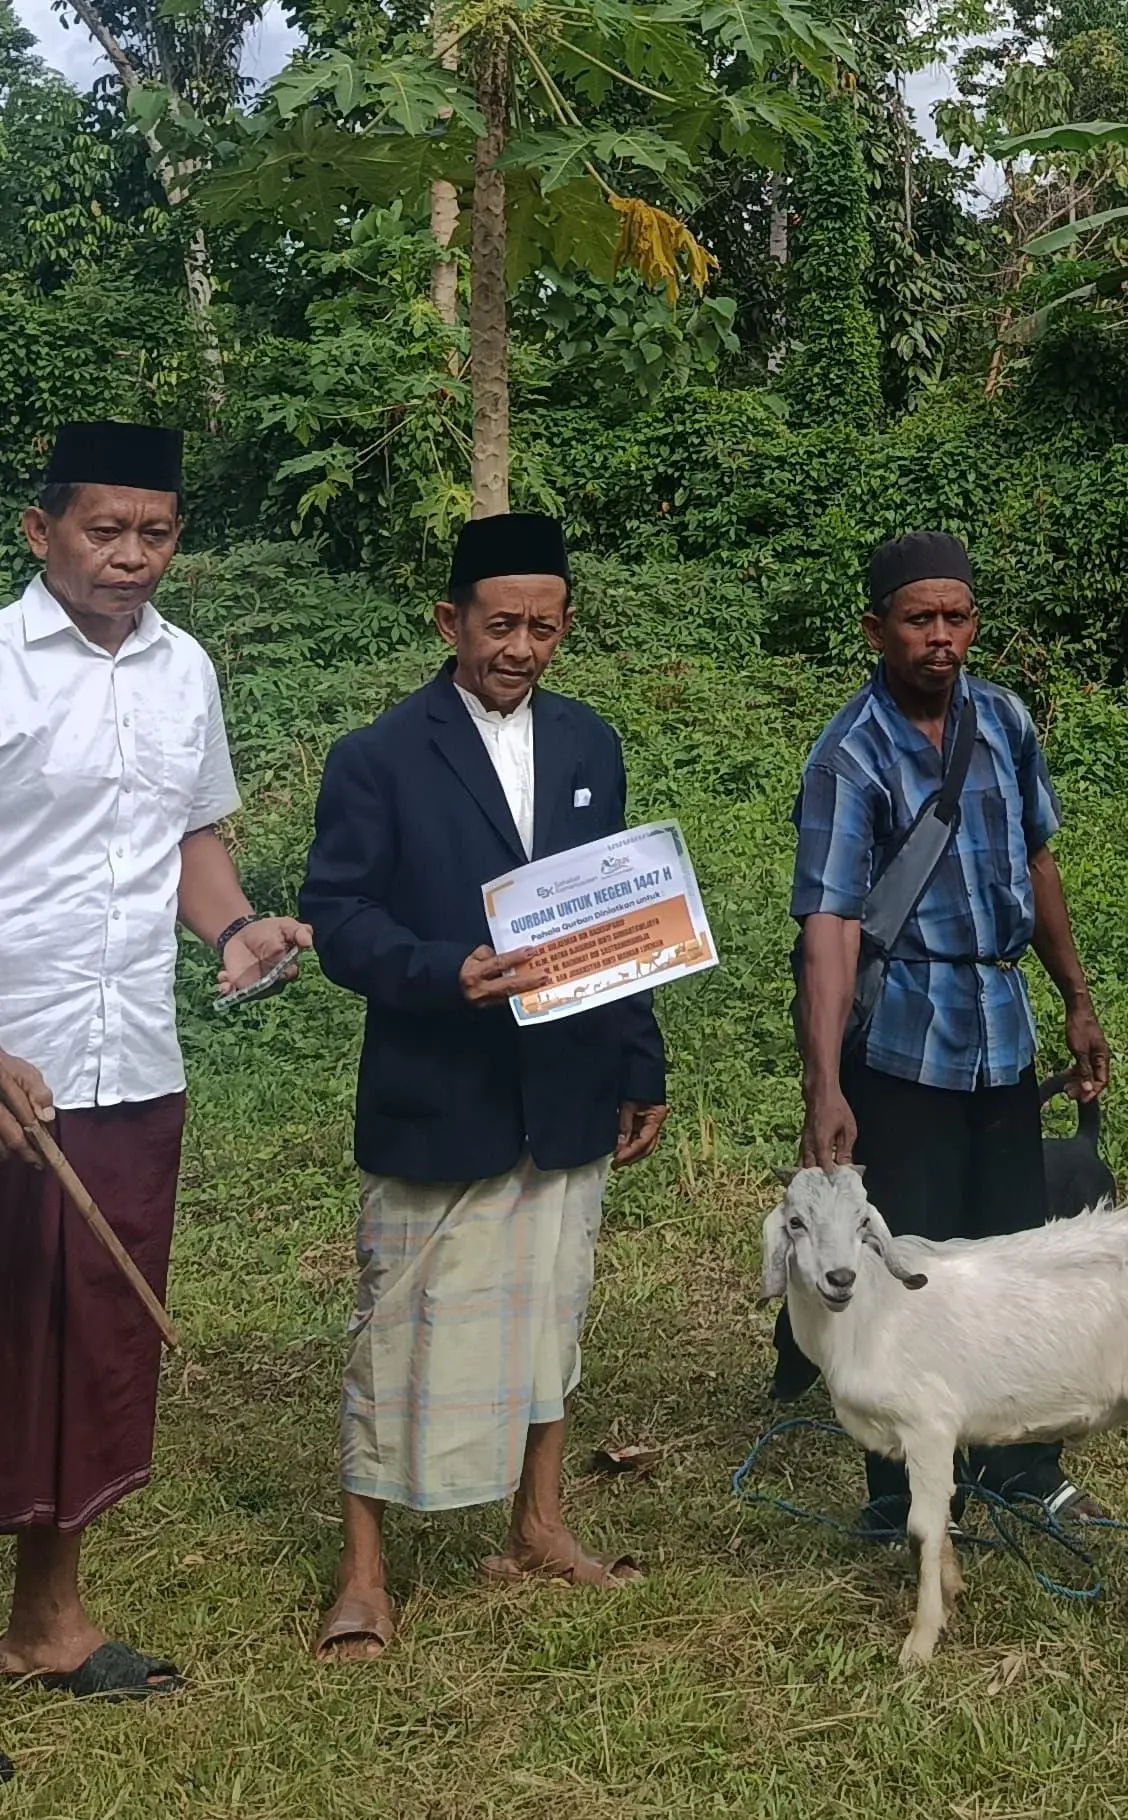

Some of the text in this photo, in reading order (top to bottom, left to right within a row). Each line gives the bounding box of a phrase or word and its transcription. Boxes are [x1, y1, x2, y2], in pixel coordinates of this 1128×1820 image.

[510, 907, 556, 934] QURBAN
[557, 894, 593, 917] UNTUK
[594, 881, 633, 905] NEGERI
[633, 870, 660, 891] 1447
[662, 865, 673, 880] H
[531, 926, 561, 942] Pahala
[561, 914, 594, 931] Qurban
[594, 901, 635, 919] Diniatkan
[635, 891, 661, 905] untuk
